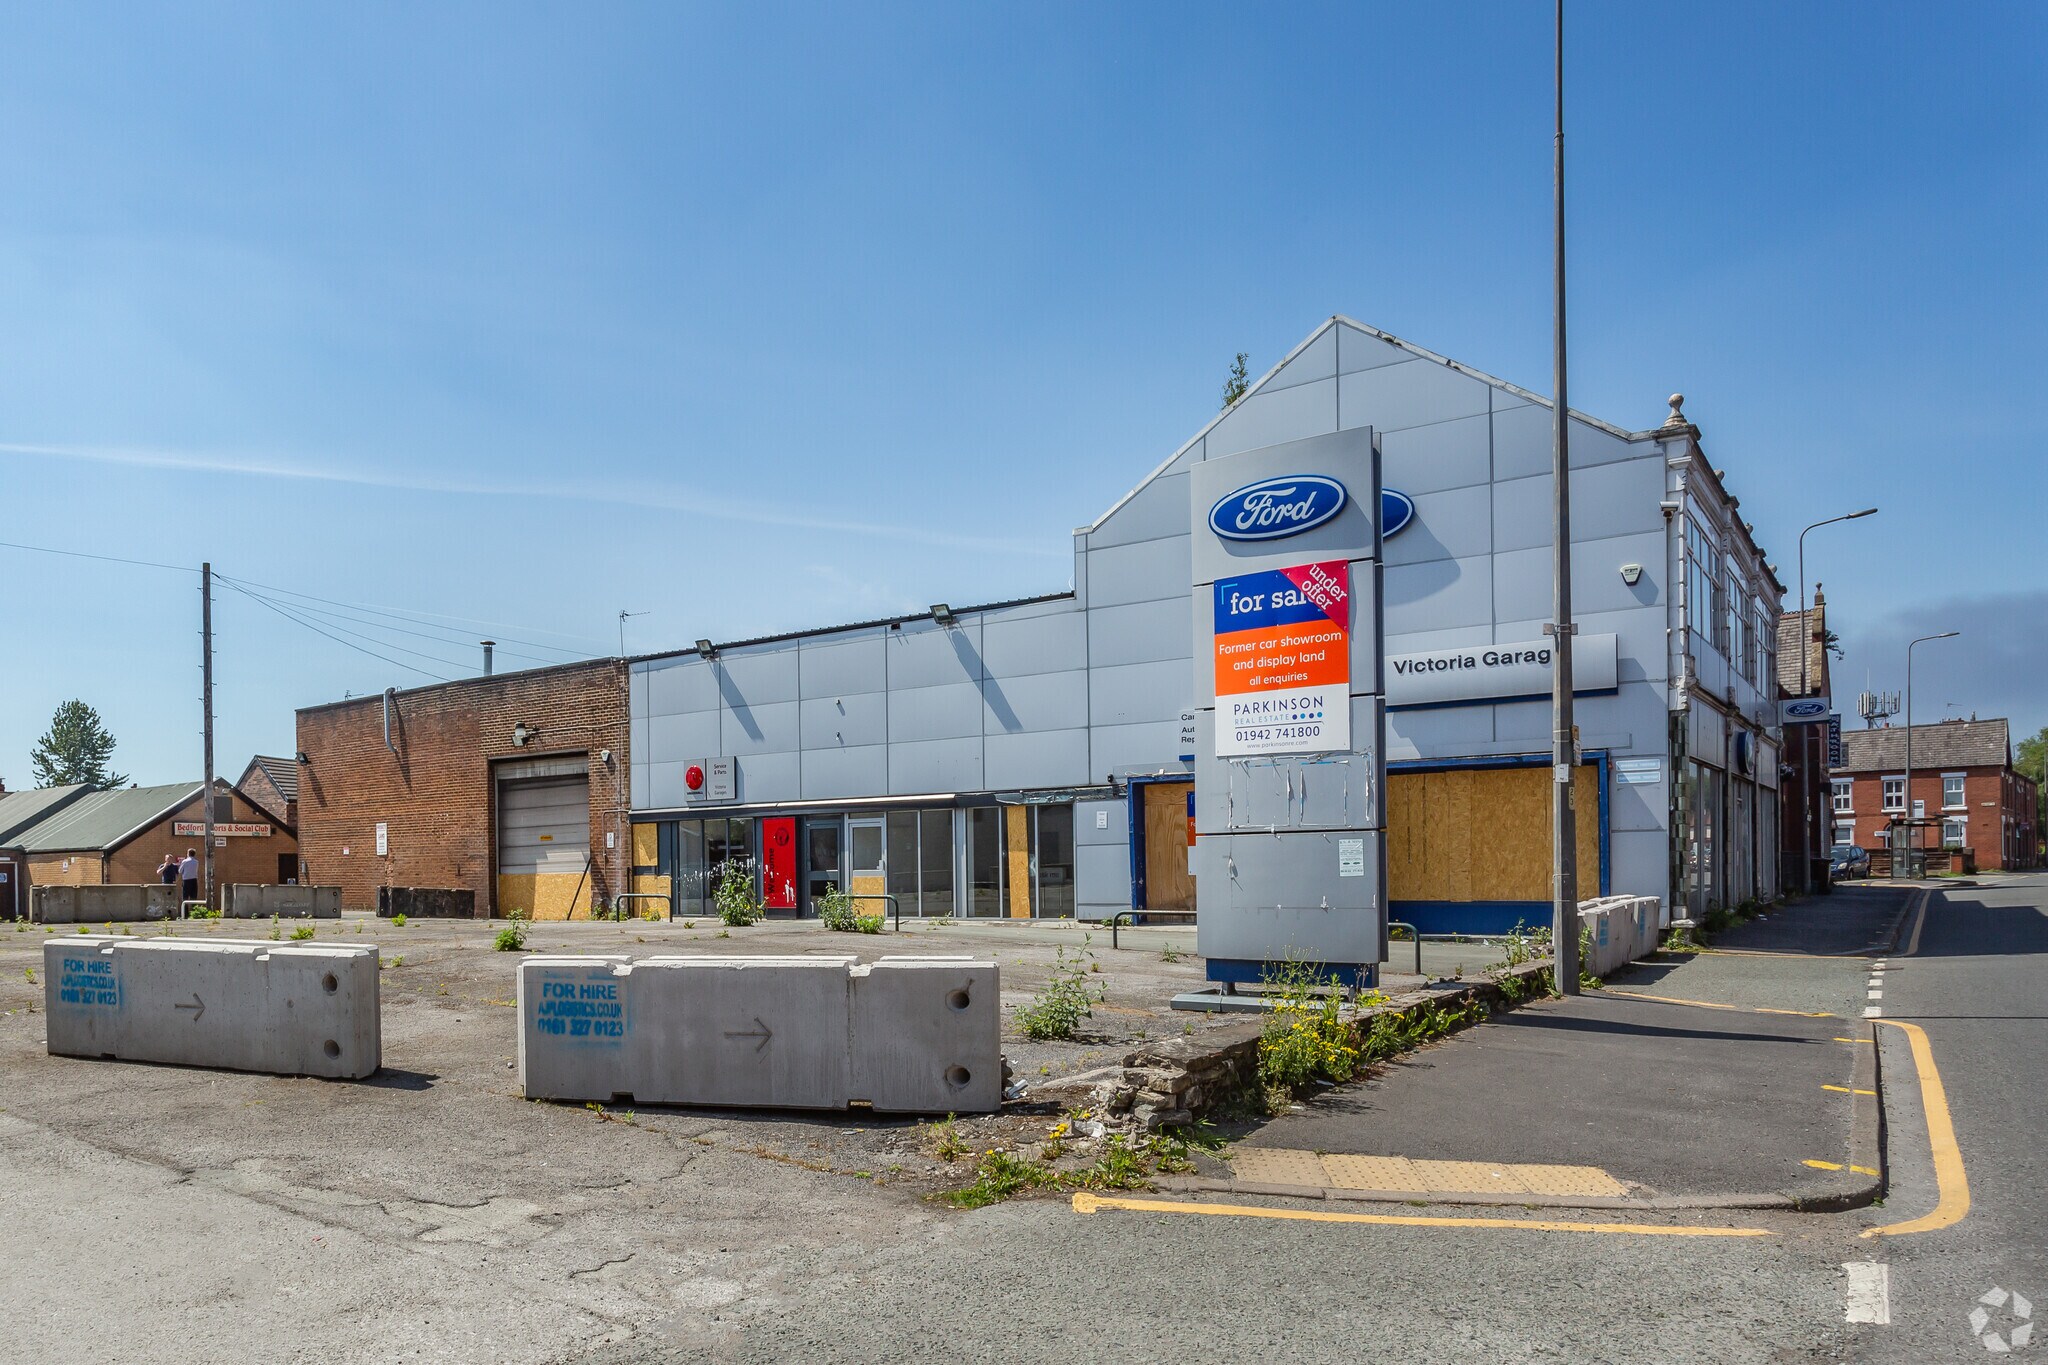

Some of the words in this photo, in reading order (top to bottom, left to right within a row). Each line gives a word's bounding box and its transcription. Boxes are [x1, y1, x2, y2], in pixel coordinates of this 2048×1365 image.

[1235, 486, 1318, 530] Ford
[1309, 564, 1347, 602] under
[1230, 592, 1265, 615] for
[1301, 580, 1333, 610] offer
[1219, 642, 1257, 655] Former
[1259, 639, 1277, 649] car
[1280, 632, 1342, 647] showroom
[1233, 658, 1254, 671] and
[1256, 655, 1296, 669] display
[1299, 650, 1325, 663] land
[1393, 654, 1476, 675] Victoria
[1482, 648, 1551, 667] Garag
[1249, 675, 1261, 686] all
[1263, 672, 1308, 685] enquiries
[1234, 695, 1323, 715] PARKINSON
[1794, 704, 1818, 714] Ford
[1234, 717, 1255, 725] REAL
[1258, 713, 1289, 723] ESTATE
[1236, 729, 1271, 742] 01942
[1275, 726, 1320, 739] 741800
[177, 823, 204, 831] Bedford
[228, 824, 233, 832] &
[254, 825, 269, 833] Club
[63, 958, 85, 973] FOR
[87, 960, 112, 974] HIRE
[97, 991, 117, 1005] 0123
[543, 982, 576, 999] FOR
[580, 984, 617, 1000] HIRE
[537, 1018, 566, 1035] 0161
[569, 1019, 592, 1036] 327
[593, 1020, 624, 1037] 0123
